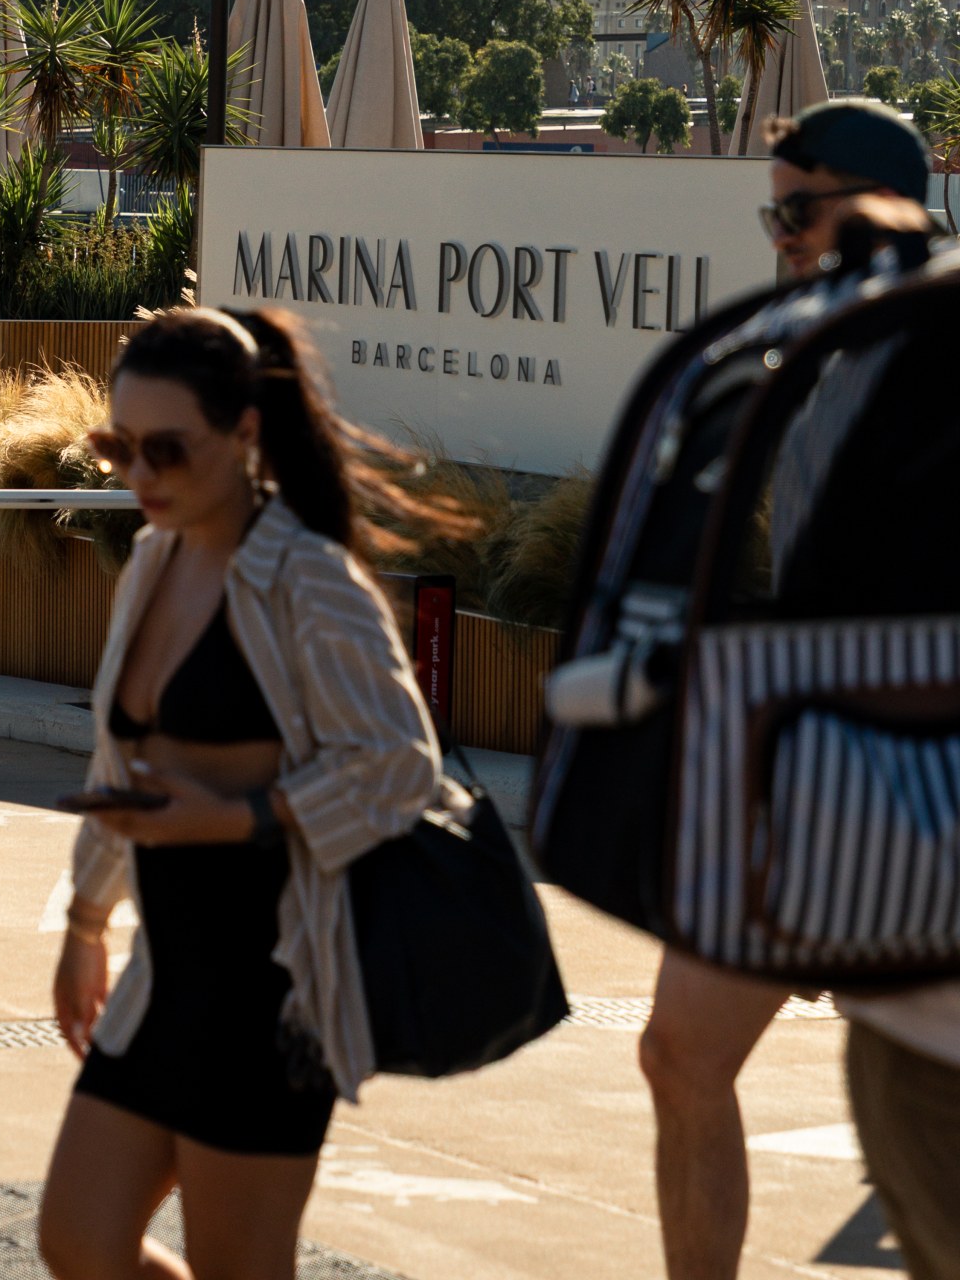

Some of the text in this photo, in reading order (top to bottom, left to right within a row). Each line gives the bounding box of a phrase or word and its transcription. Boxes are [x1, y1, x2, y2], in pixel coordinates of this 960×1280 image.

[233, 230, 418, 311] MARINA
[438, 241, 578, 322] PORT
[351, 339, 562, 386] BARCELONA
